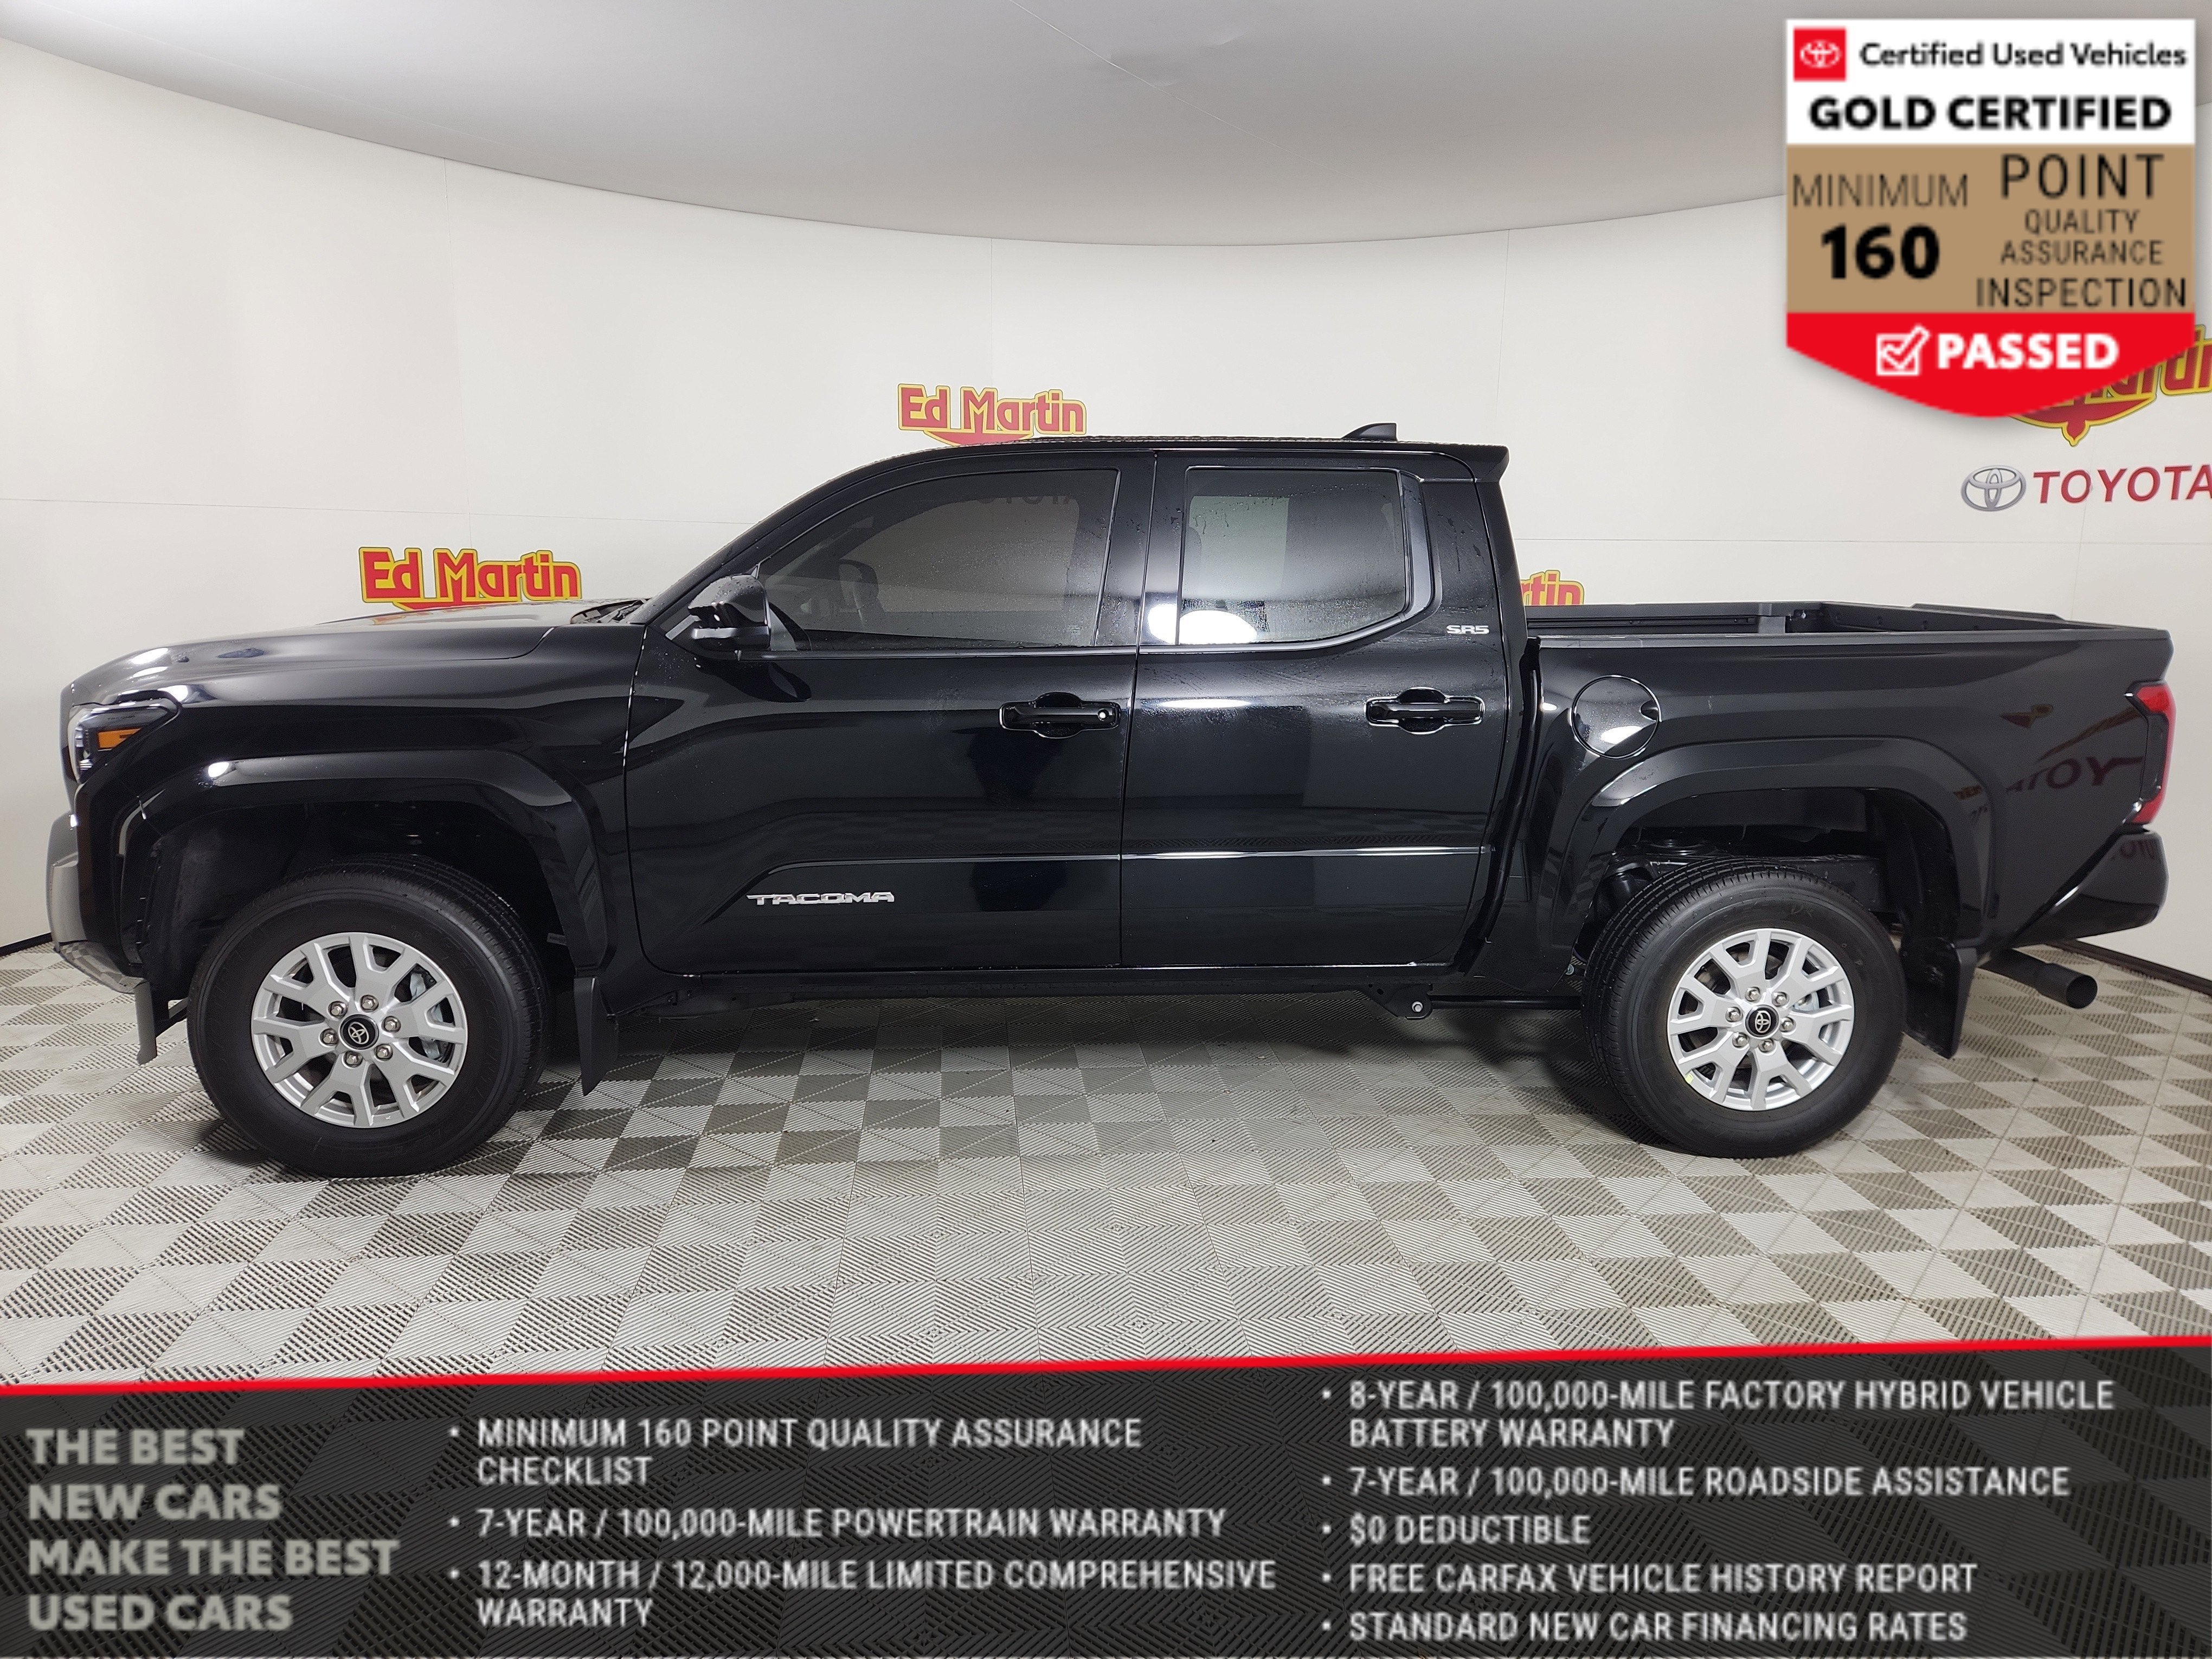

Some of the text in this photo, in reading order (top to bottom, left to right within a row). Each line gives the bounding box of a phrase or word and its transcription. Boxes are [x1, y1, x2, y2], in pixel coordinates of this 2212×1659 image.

[898, 384, 1086, 435] Ed Martin
[2034, 465, 2212, 504] TOYOTA
[360, 548, 581, 602] Ed Martin
[1520, 570, 1584, 606] rtin
[1446, 625, 1489, 635] SR5
[746, 892, 895, 905] TACOMA
